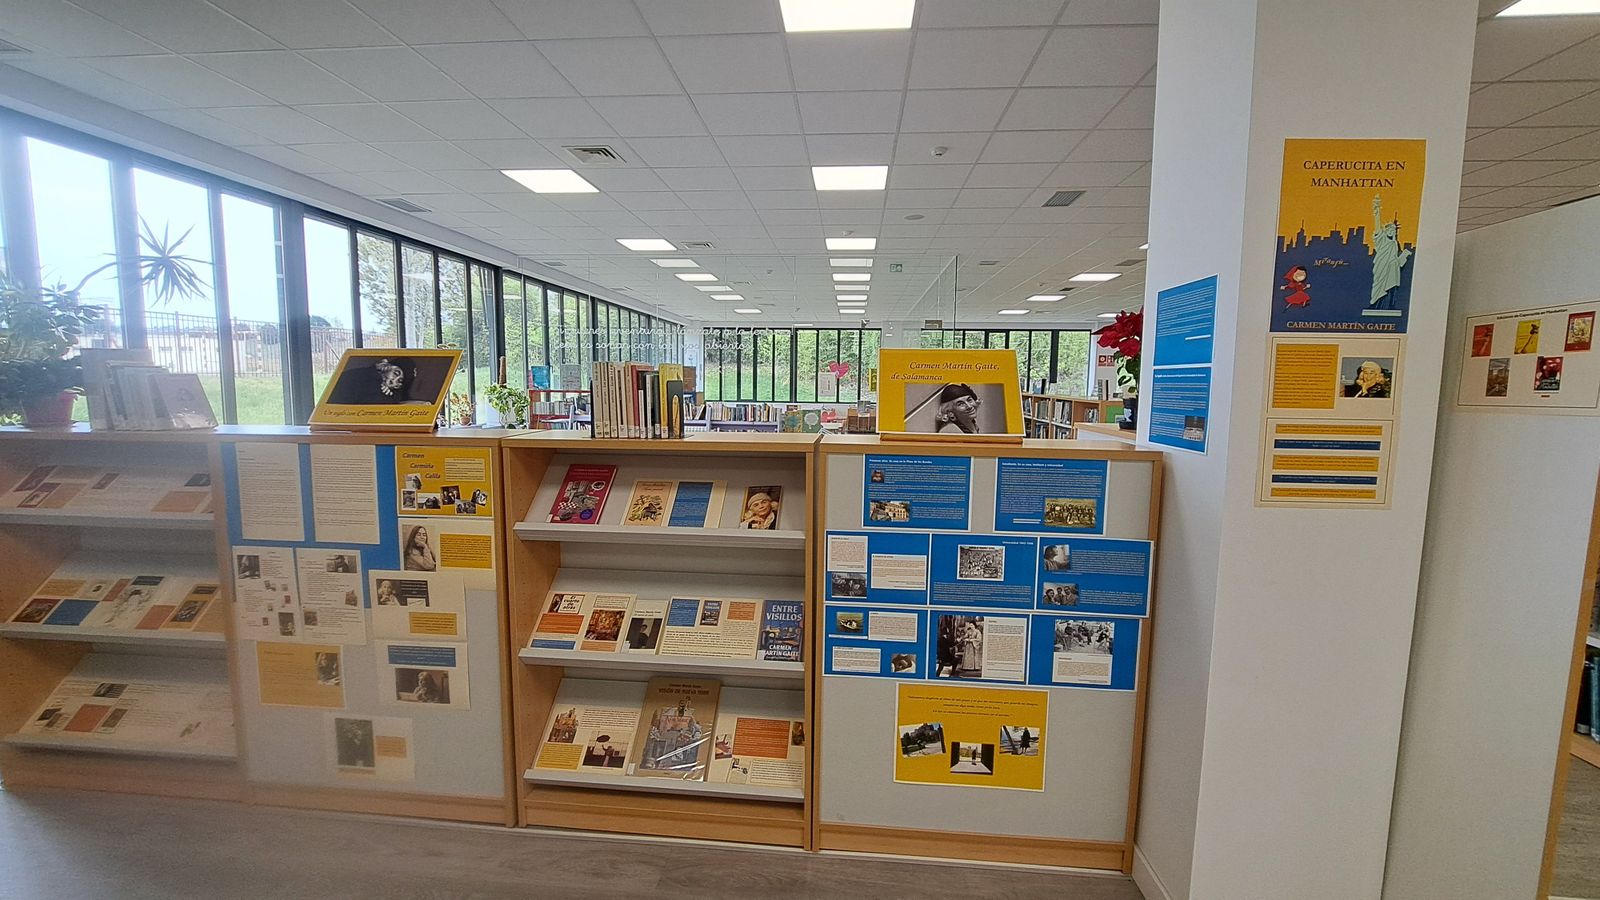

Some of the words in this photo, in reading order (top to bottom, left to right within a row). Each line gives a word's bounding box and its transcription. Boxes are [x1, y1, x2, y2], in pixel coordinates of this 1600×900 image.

[1303, 160, 1382, 170] CAPERUCITA
[1386, 161, 1406, 170] EN
[1310, 178, 1395, 188] MANHATTAN
[1286, 321, 1326, 329] CARMEN
[1328, 321, 1365, 330] MARTÍN
[1367, 322, 1396, 331] GAITE
[909, 362, 941, 370] Carmen
[942, 362, 972, 370] Martín
[975, 362, 1000, 371] Gaite,
[766, 613, 802, 621] VISILLOS
